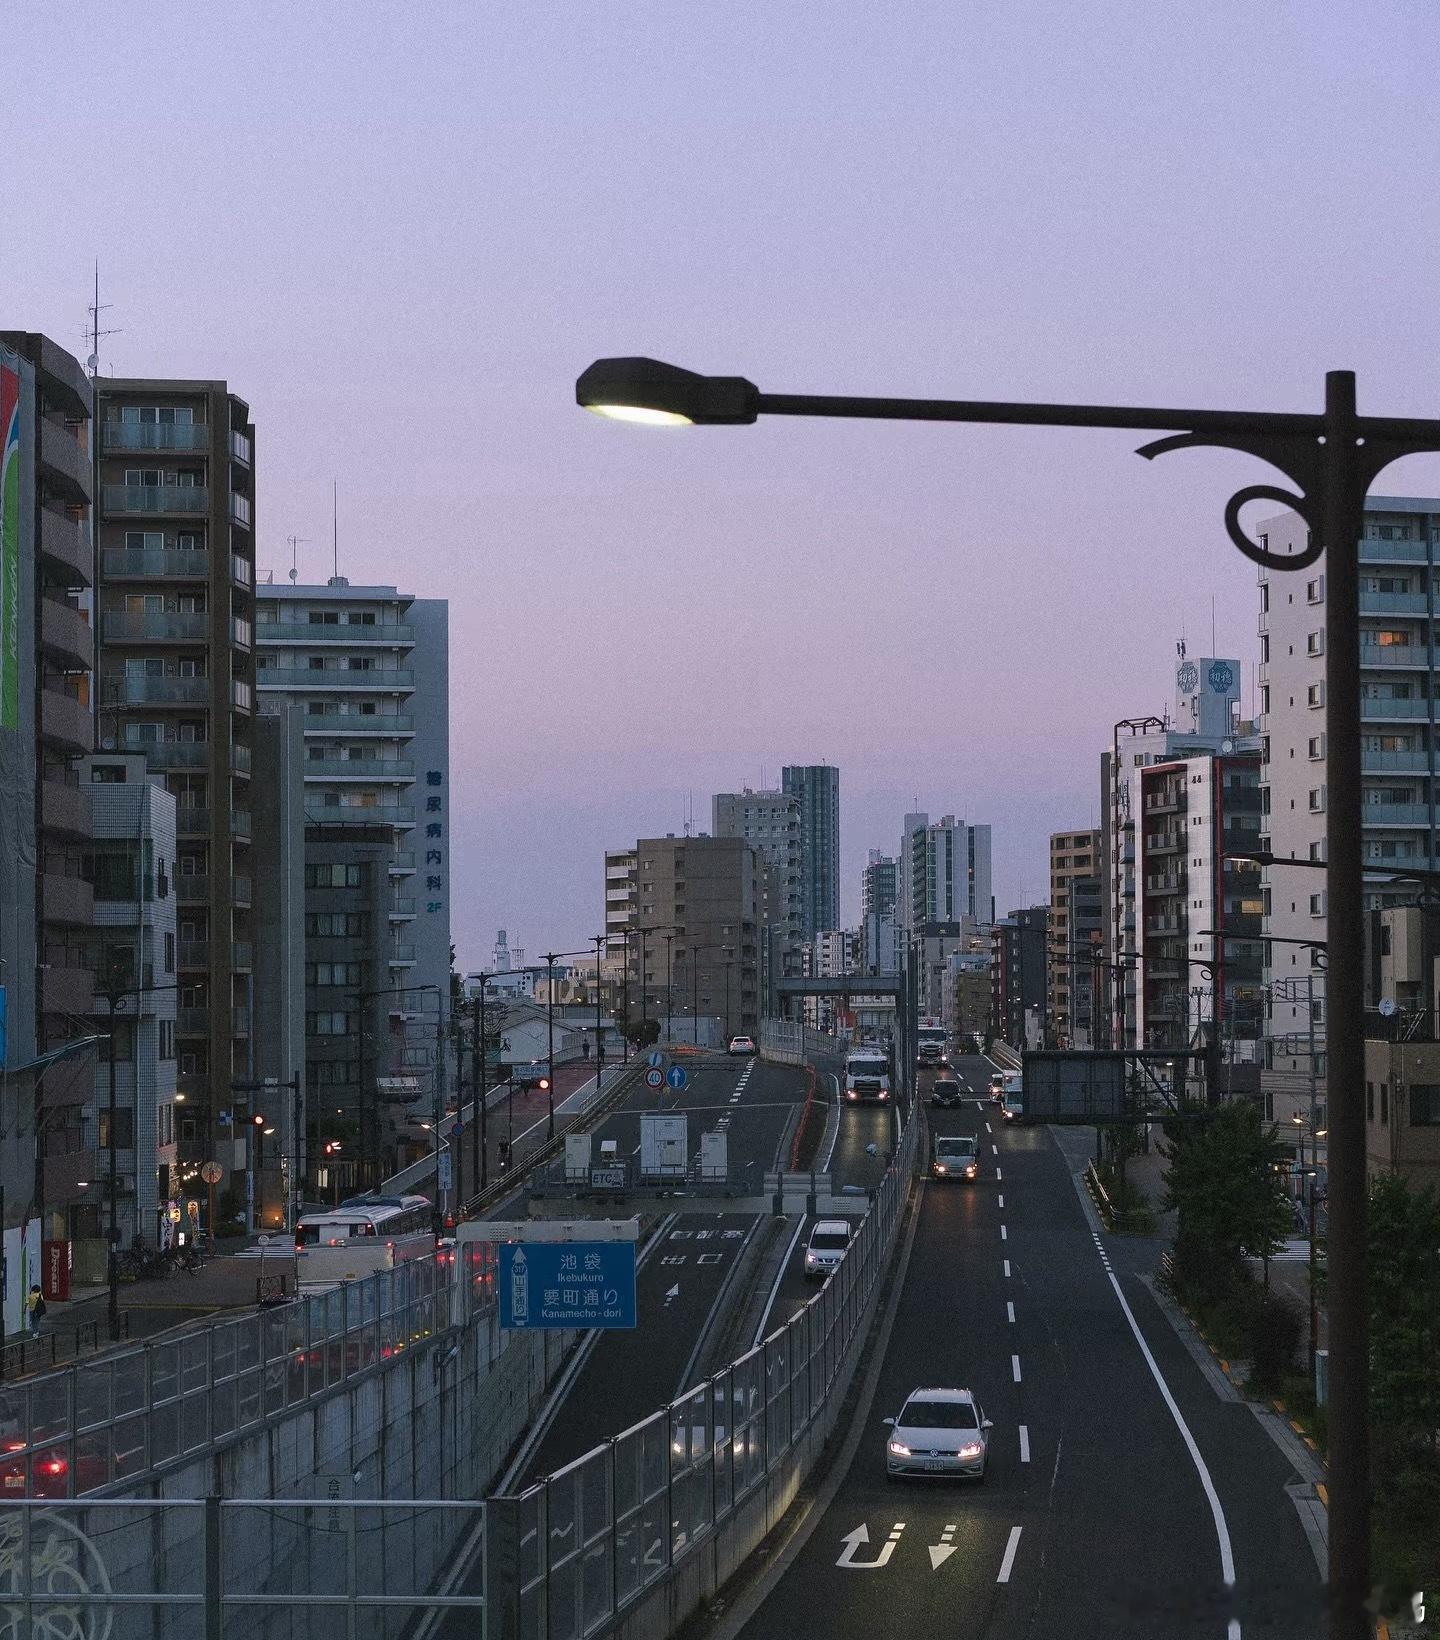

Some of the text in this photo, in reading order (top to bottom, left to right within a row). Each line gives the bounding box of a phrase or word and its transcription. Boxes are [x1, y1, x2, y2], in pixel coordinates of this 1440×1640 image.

[426, 770, 442, 891] 糖尿病内科
[426, 902, 442, 913] 2F
[650, 1072, 660, 1083] 40
[560, 1253, 601, 1270] 池袋
[514, 1264, 525, 1273] 317
[557, 1272, 604, 1282] Ikebukuro
[543, 1288, 618, 1306] 要町通り
